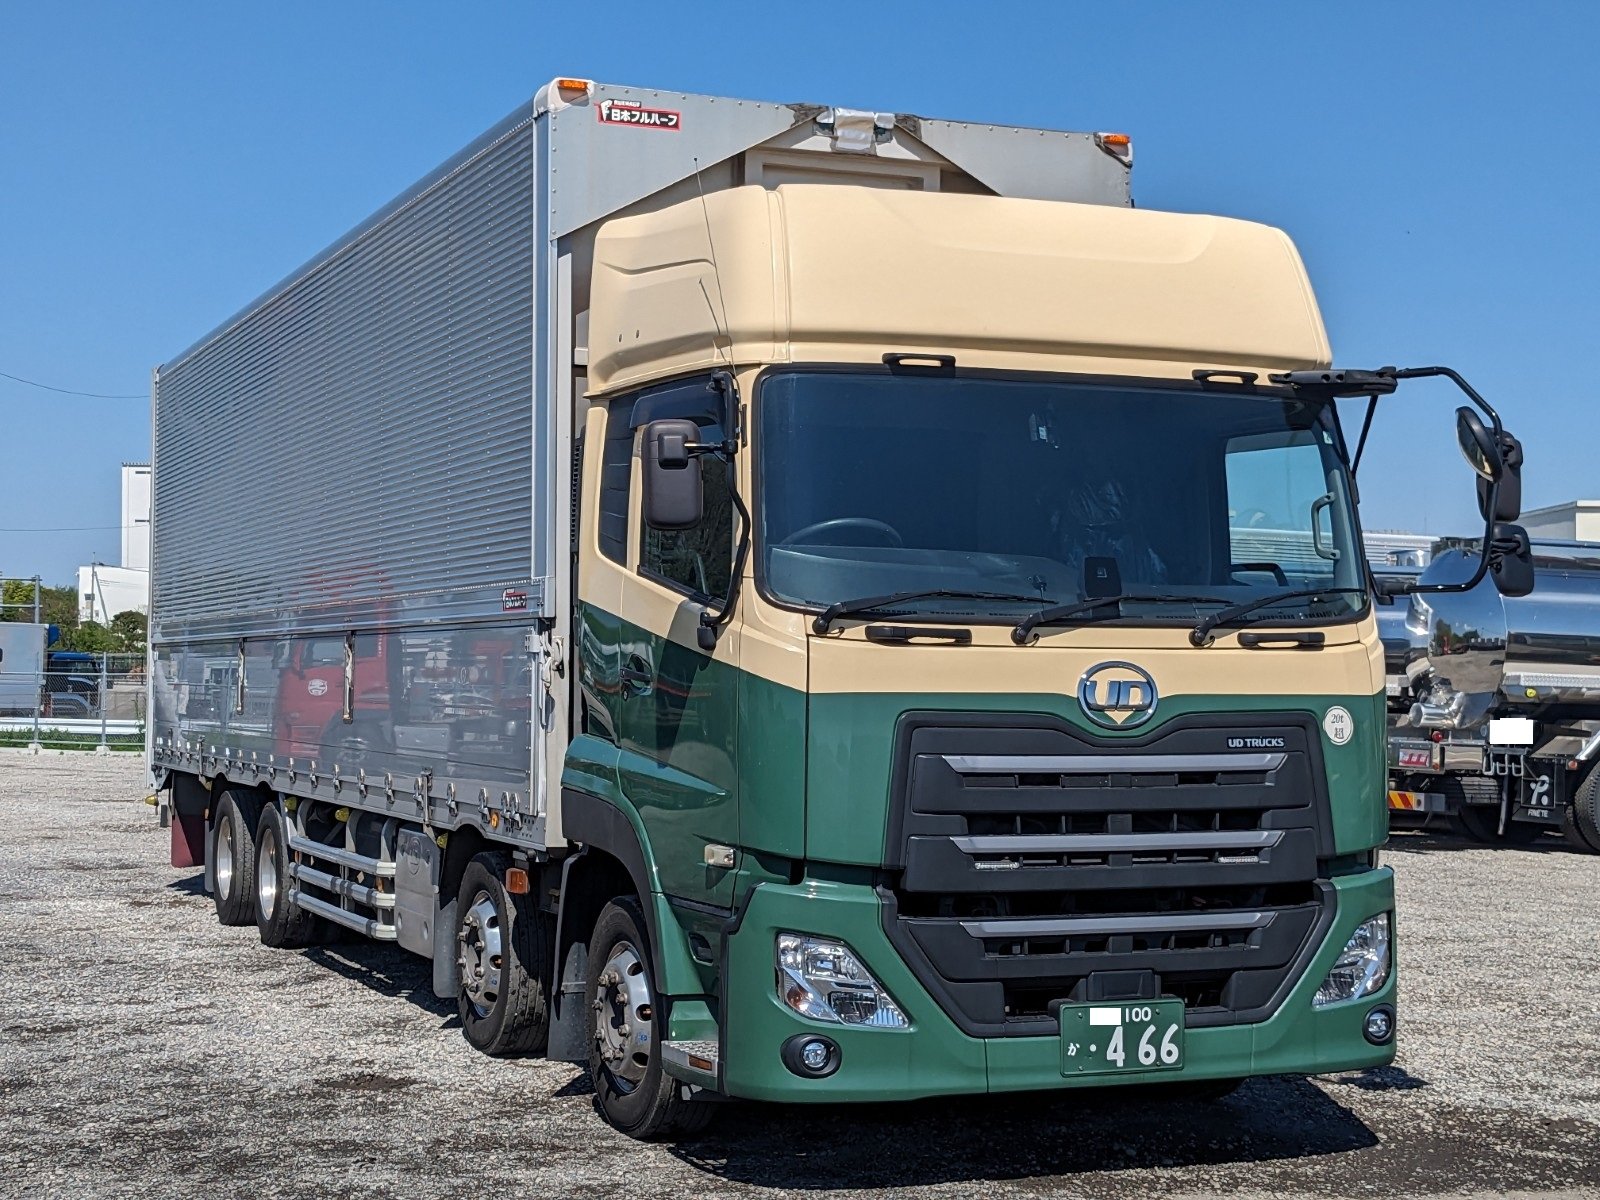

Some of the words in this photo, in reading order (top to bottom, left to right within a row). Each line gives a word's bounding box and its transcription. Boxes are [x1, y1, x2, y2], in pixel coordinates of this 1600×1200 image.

[611, 108, 678, 126] 日本フルハーフ
[1084, 680, 1153, 711] UD
[1228, 738, 1244, 748] UD
[1244, 737, 1285, 748] TRUCKS
[1125, 1006, 1152, 1023] 100
